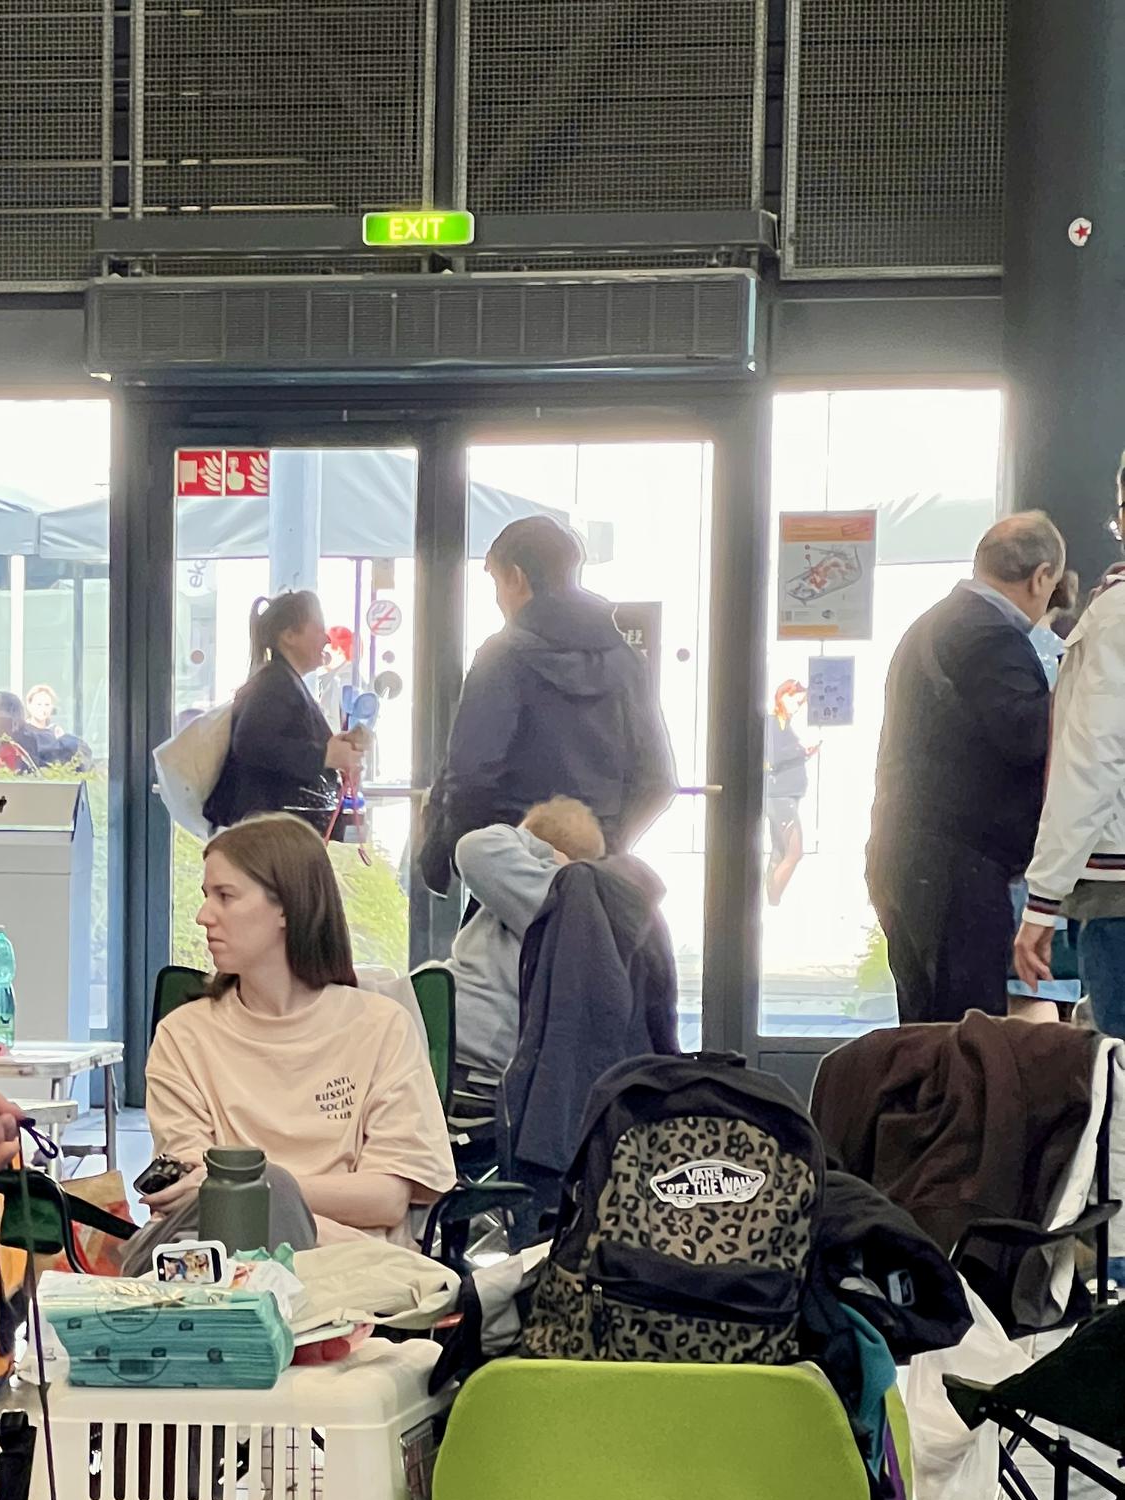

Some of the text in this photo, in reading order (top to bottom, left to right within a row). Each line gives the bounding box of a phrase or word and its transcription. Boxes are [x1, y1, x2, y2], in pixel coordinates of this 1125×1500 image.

[389, 217, 444, 241] EXIT
[326, 1077, 351, 1090] ANTI
[685, 1167, 724, 1184] VANS
[690, 1180, 719, 1195] THE
